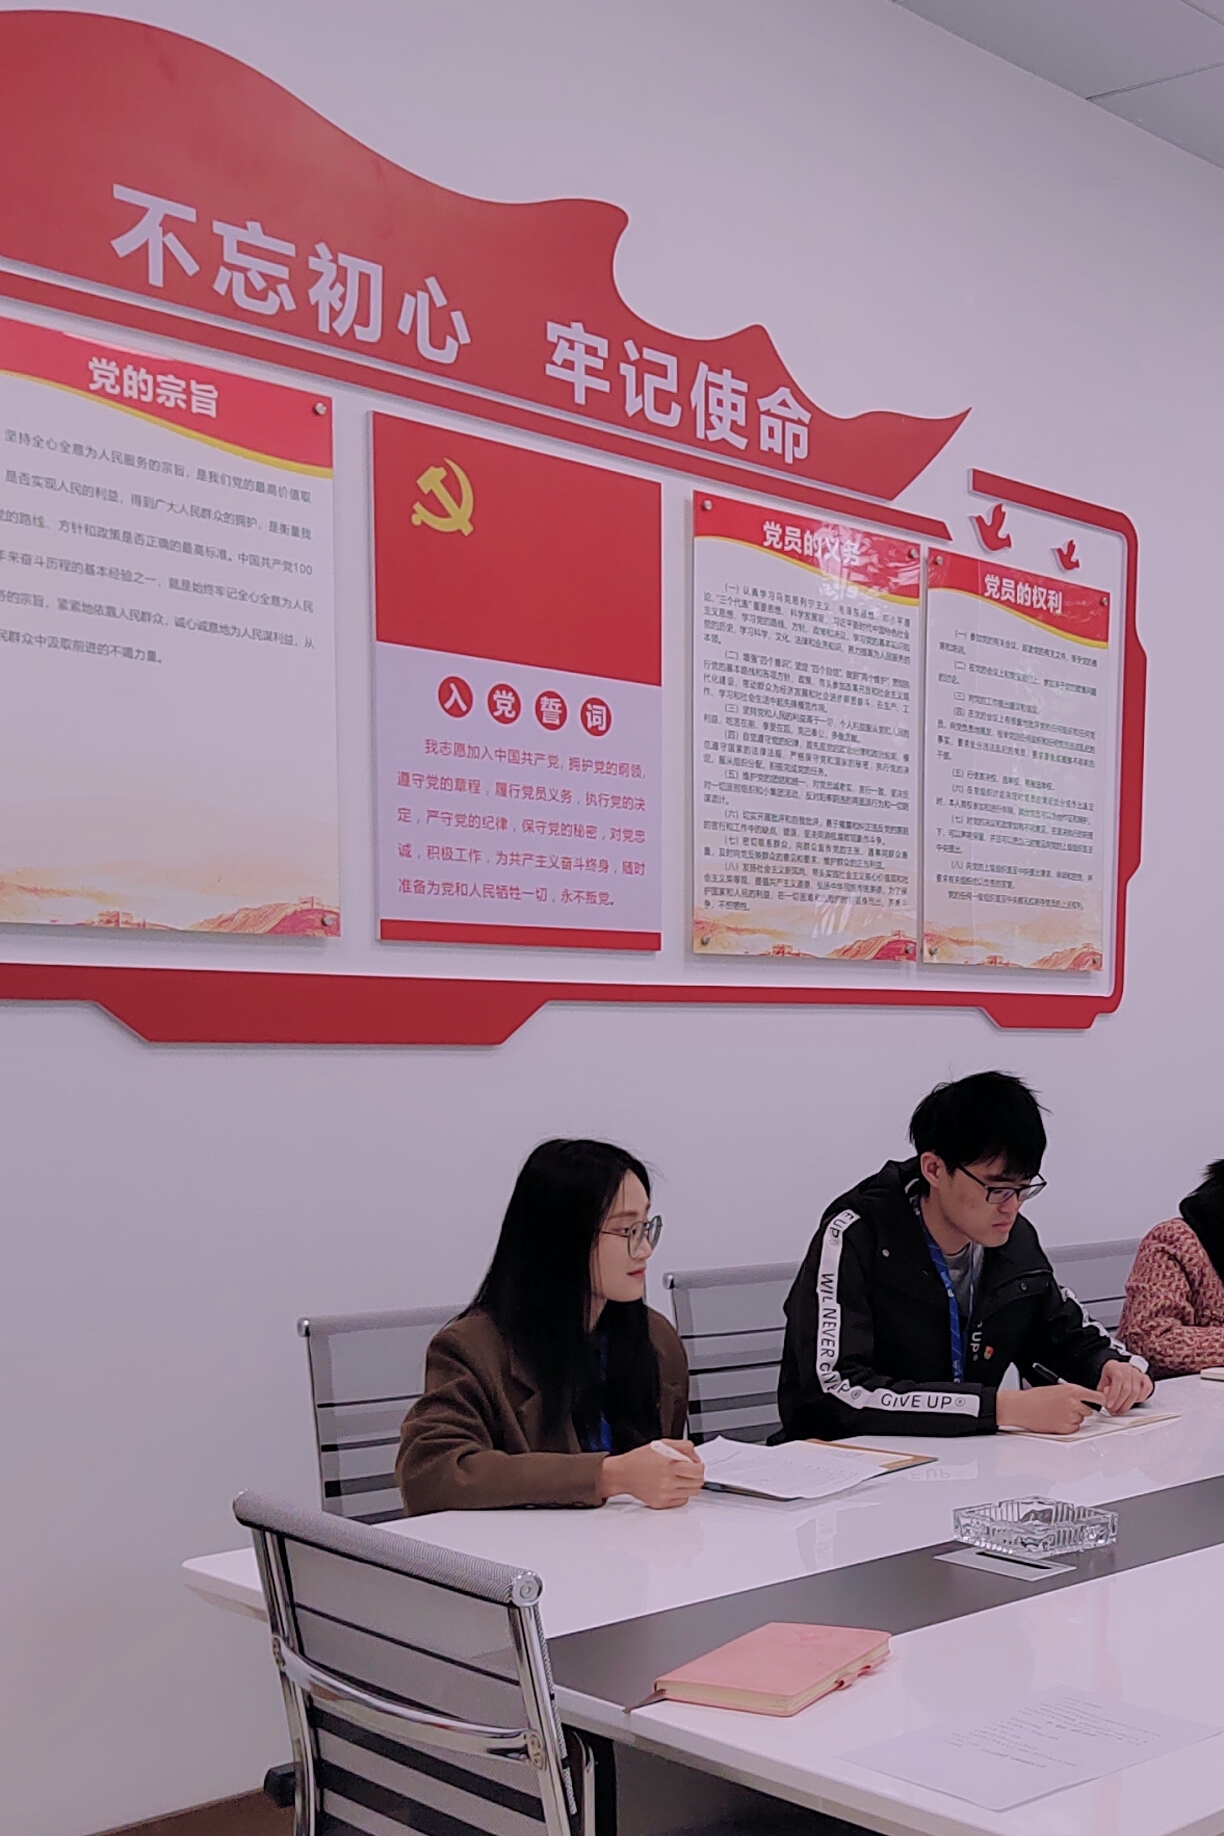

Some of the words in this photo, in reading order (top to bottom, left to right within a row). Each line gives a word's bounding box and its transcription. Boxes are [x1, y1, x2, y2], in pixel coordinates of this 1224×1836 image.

[110, 183, 470, 364] 不忘初心
[546, 321, 811, 464] 牢记使命
[88, 355, 220, 418] 党的宗旨
[763, 520, 861, 566] 党员的义务
[984, 573, 1063, 614] 党员的权利
[442, 682, 607, 731] 入党誓词
[820, 1308, 837, 1358] NEVER
[881, 1393, 922, 1408] GIVE
[927, 1395, 953, 1409] UP
